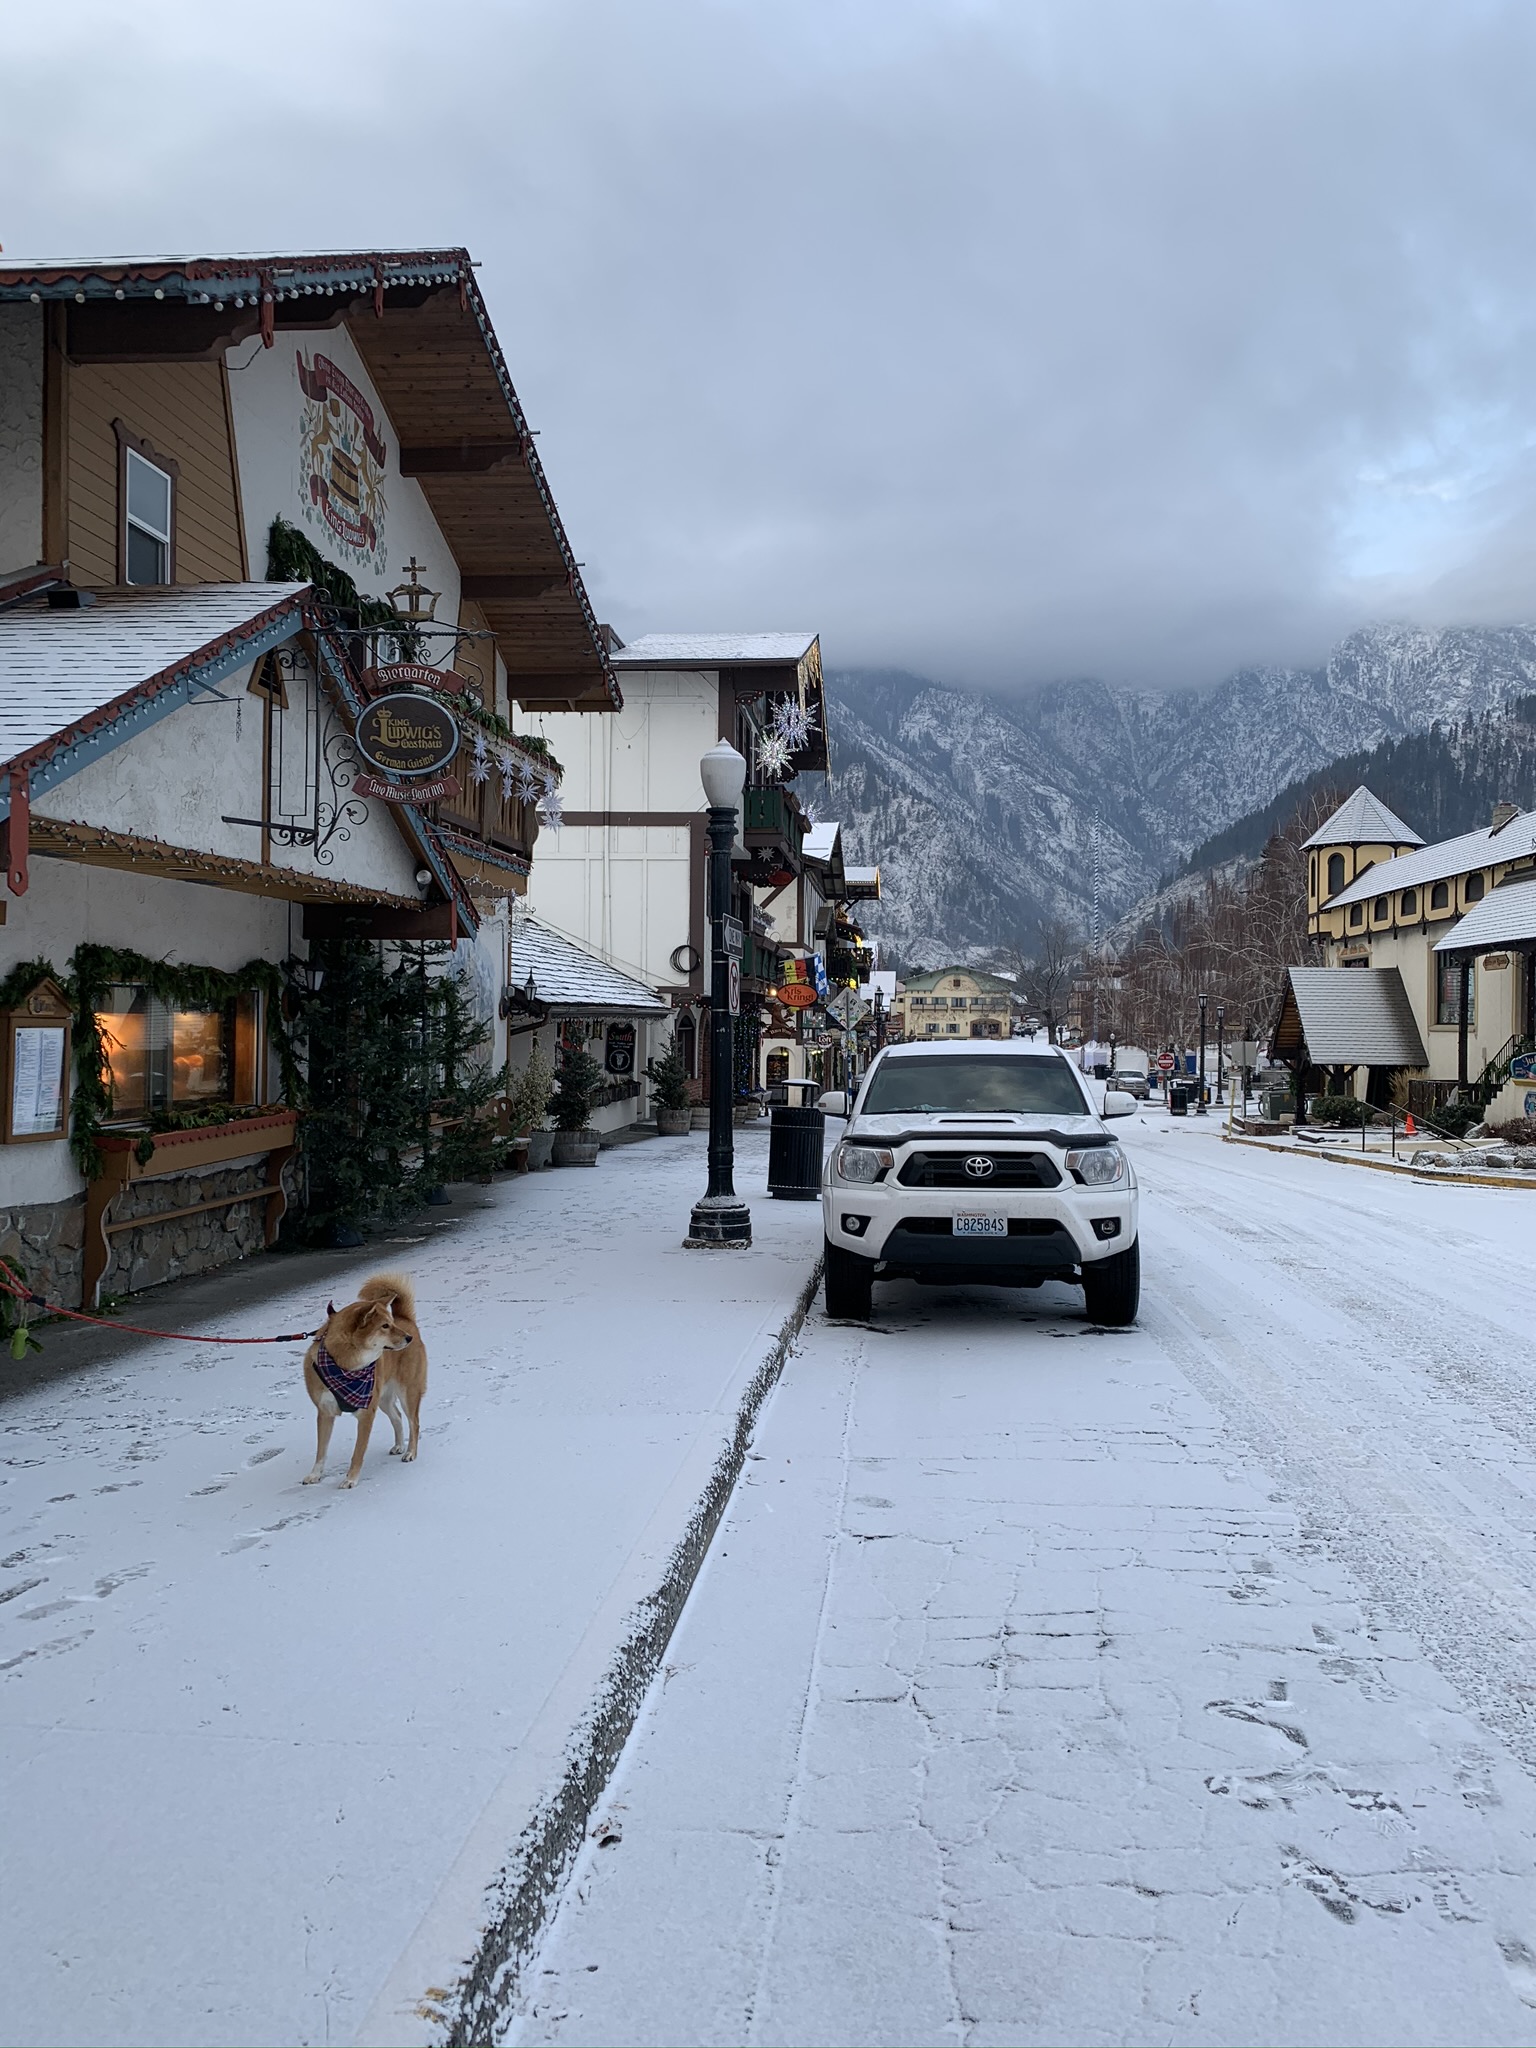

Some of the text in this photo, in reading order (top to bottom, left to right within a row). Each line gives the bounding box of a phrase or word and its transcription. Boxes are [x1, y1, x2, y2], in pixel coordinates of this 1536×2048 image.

[377, 667, 441, 685] Biergarten
[388, 718, 410, 727] KING
[369, 717, 442, 748] LUDWIG'S
[400, 738, 443, 750] Gasthaus
[375, 750, 435, 769] German Cuisine
[368, 779, 445, 801] Live Music Dancing
[784, 986, 802, 995] Kris
[786, 993, 814, 1002] Kringl
[608, 1031, 633, 1042] South
[956, 1217, 1004, 1232] C82584S
